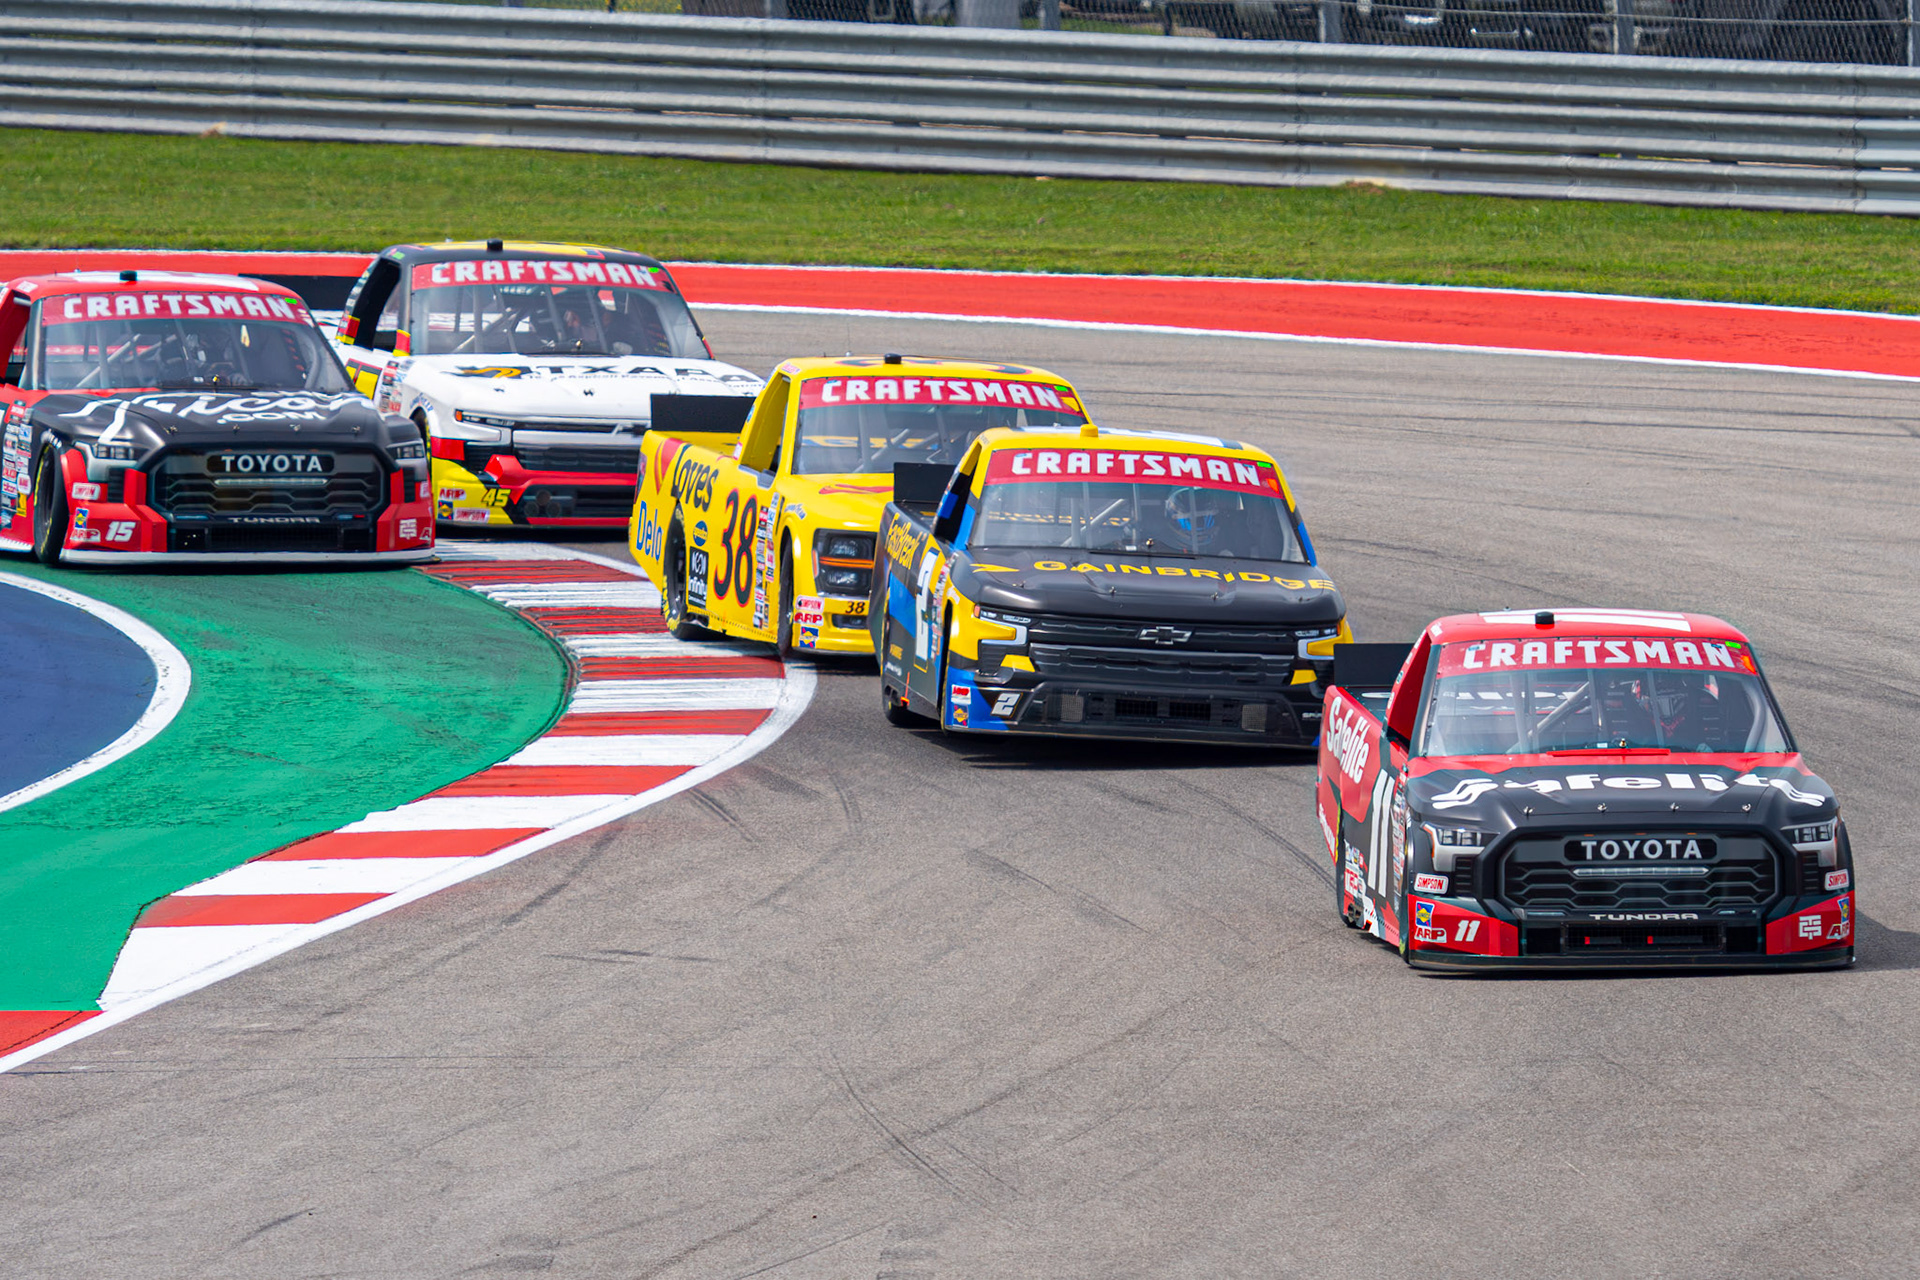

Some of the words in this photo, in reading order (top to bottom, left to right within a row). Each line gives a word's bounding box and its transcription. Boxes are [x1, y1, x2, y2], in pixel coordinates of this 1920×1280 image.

[430, 261, 658, 287] CRAFTSMAN
[63, 294, 295, 319] CRAFTSMAN
[822, 379, 1062, 409] CRAFTSMAN
[221, 455, 323, 473] TOYOTA
[1011, 451, 1261, 487] CRAFTSMAN
[481, 489, 511, 508] 45
[105, 521, 136, 542] 15
[636, 500, 664, 562] Delo
[713, 487, 758, 609] 38
[1033, 561, 1335, 591] GAINBRIDGE
[794, 612, 823, 624] ARP
[845, 601, 866, 614] 38
[1463, 641, 1735, 668] CRAFTSMAN
[991, 692, 1022, 717] 2
[1327, 696, 1371, 784] Safelite
[1431, 773, 1826, 807] Safelite
[1367, 768, 1395, 898] 11
[1580, 839, 1703, 860] TOYOTA
[1417, 877, 1444, 890] SIMPSON
[1589, 913, 1699, 921] TUNDRA
[1416, 928, 1446, 941] ARP
[1454, 920, 1480, 942] 11
